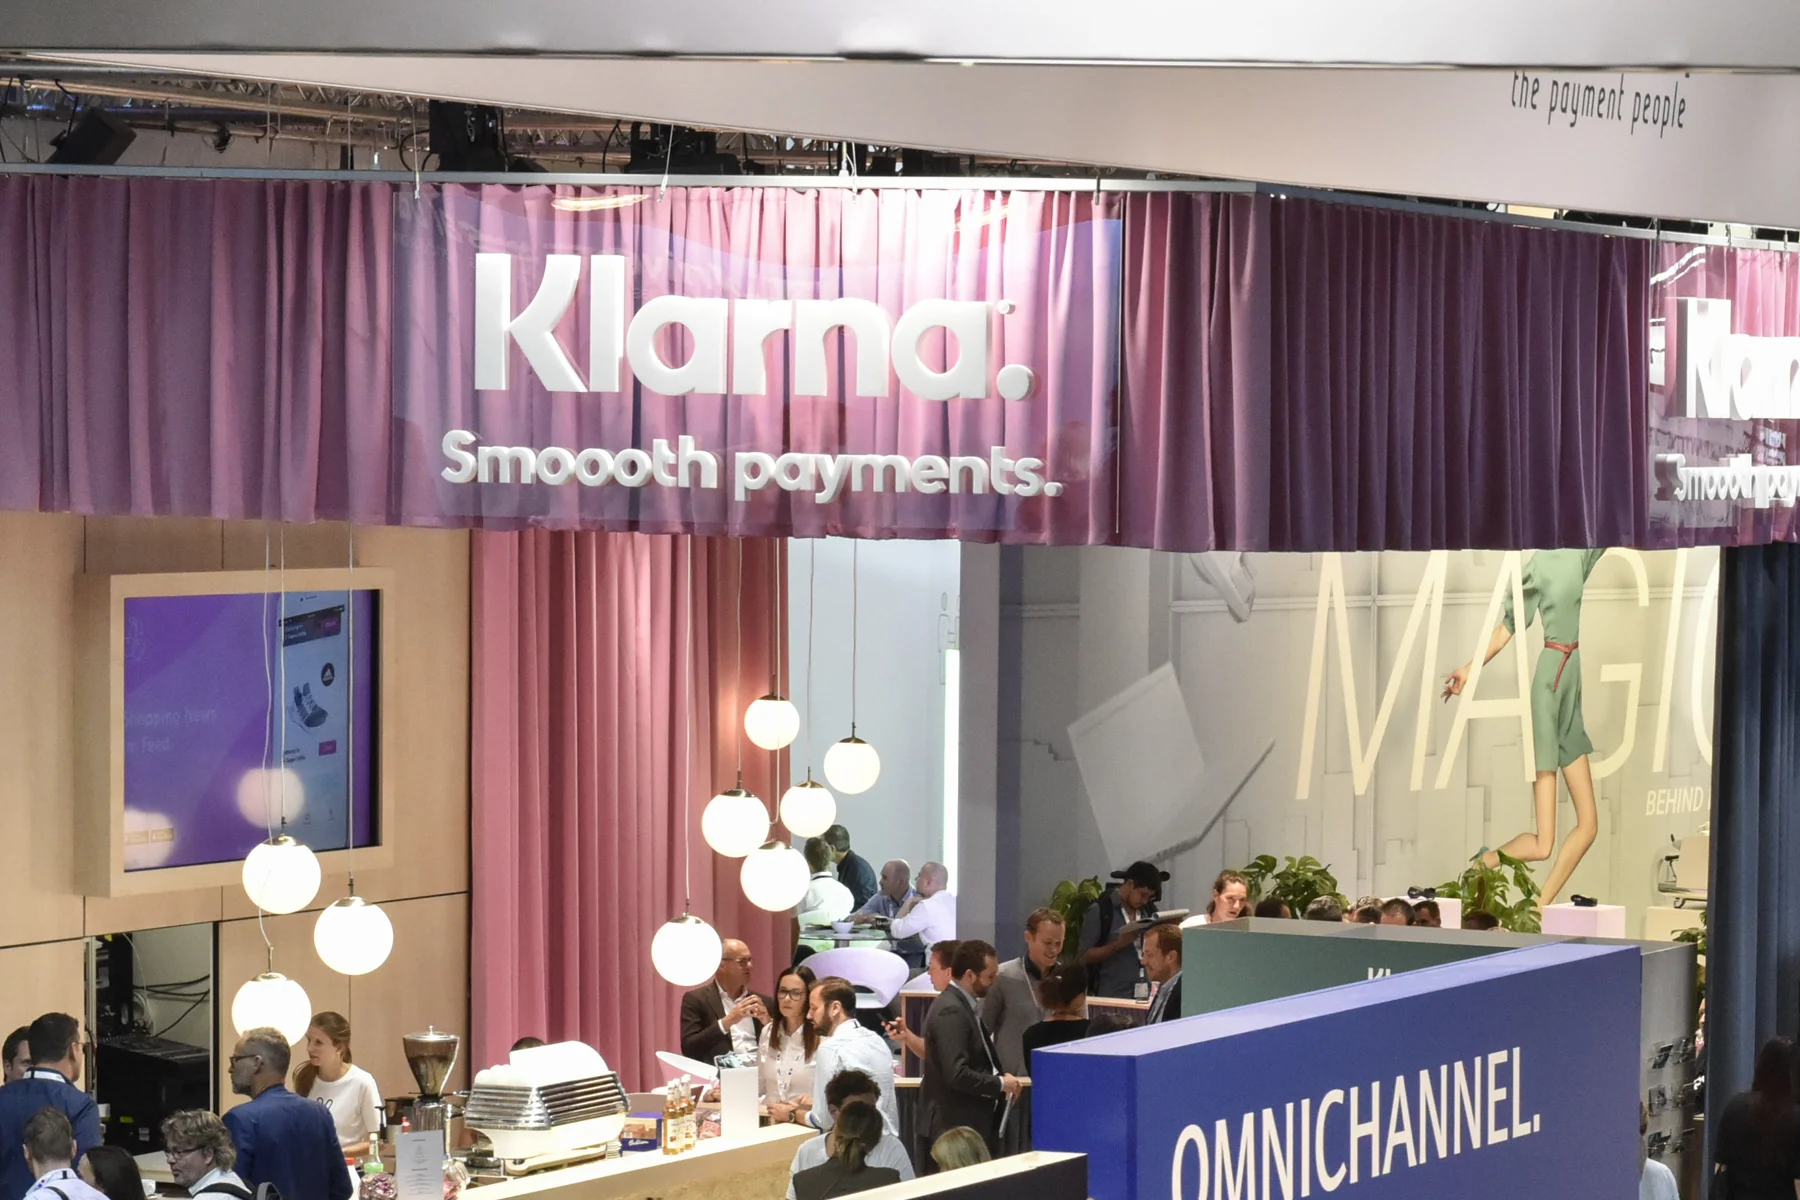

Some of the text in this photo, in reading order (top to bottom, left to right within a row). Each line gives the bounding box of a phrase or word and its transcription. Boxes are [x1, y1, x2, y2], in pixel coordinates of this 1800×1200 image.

[1547, 72, 1624, 127] payment
[1631, 83, 1686, 138] people
[440, 428, 1064, 505] Smoooth payments.
[1645, 787, 1702, 816] BEHIND
